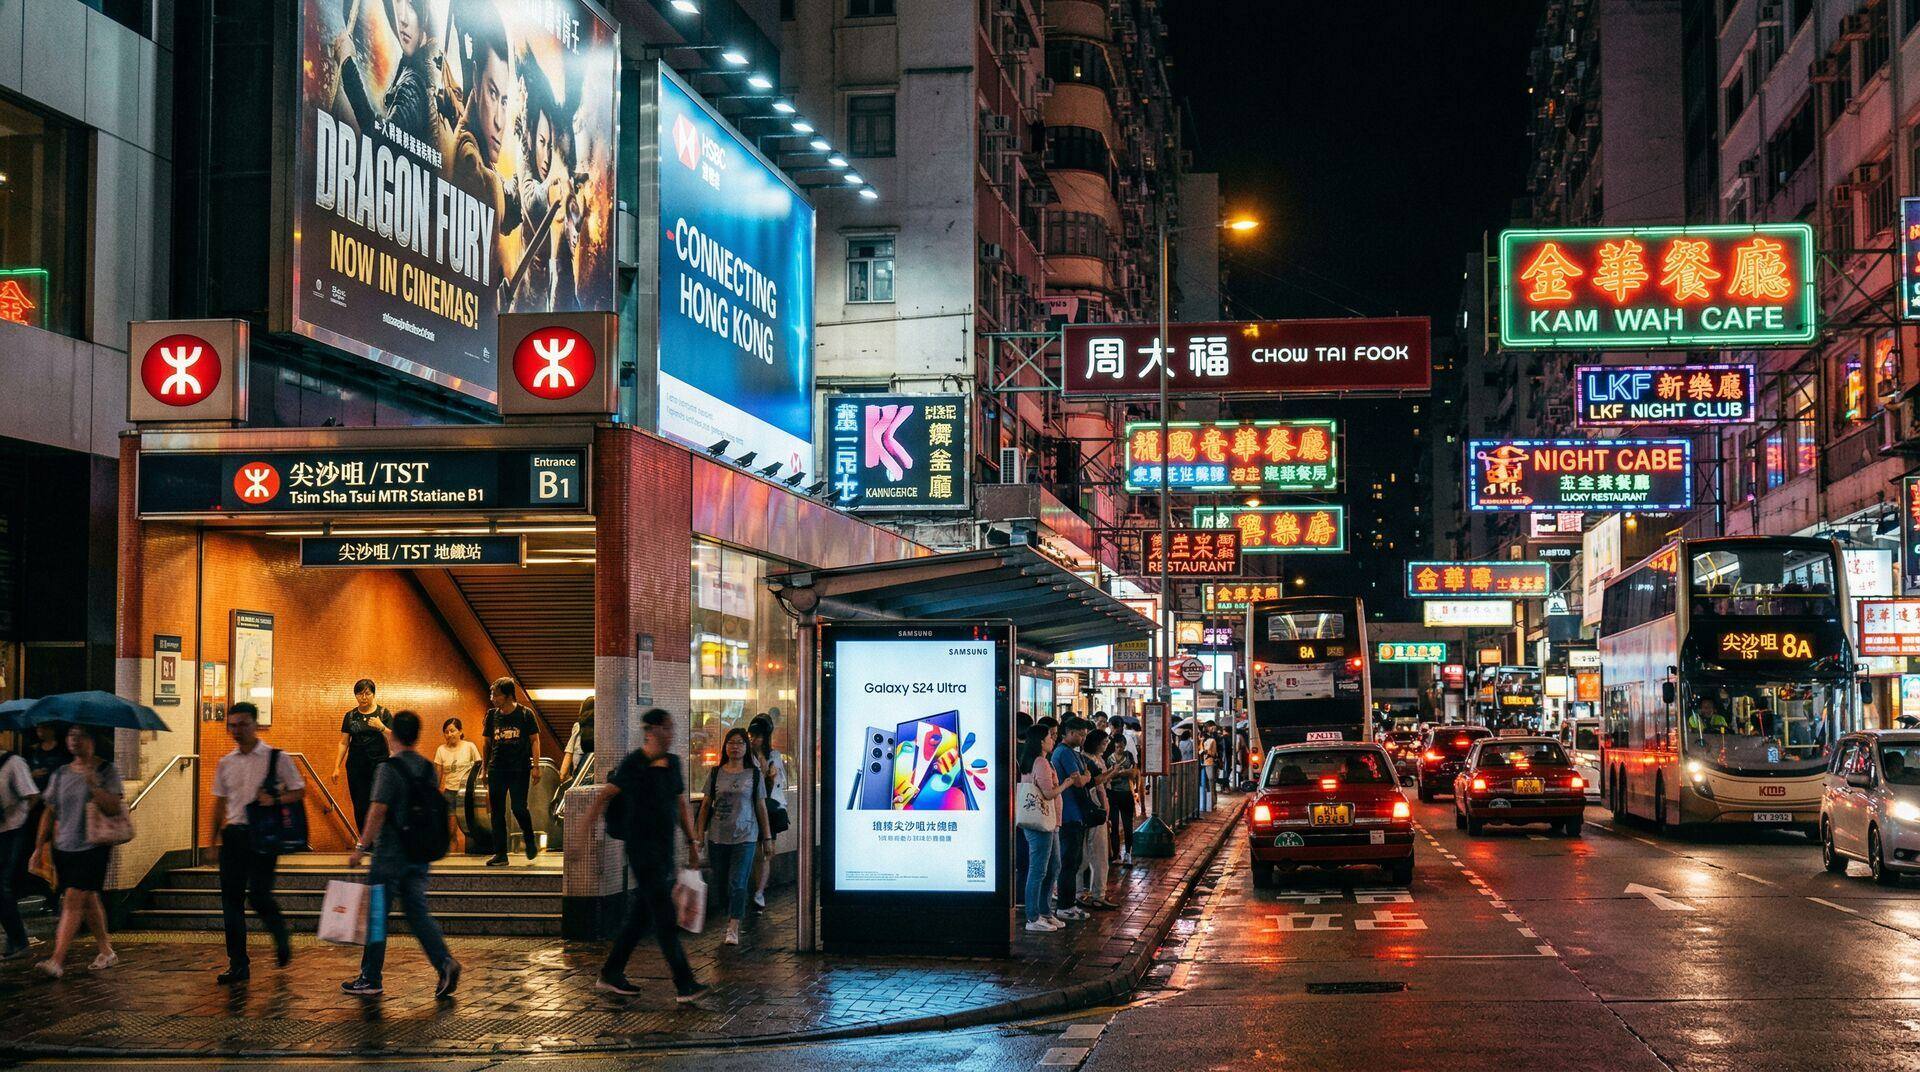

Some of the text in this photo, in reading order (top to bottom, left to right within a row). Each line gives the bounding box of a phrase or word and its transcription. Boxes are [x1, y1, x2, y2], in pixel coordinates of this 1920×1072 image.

[702, 132, 727, 170] HSBC
[316, 108, 495, 286] DRAGON FURY
[675, 217, 777, 319] CONNECTING
[1521, 239, 1791, 302] 金華餐廳
[330, 230, 374, 285] NOW
[379, 250, 398, 296] IN
[402, 263, 479, 330] CINEMAS!
[680, 273, 774, 365] HONG KONG
[1530, 306, 1784, 333] KAM WAH CAFE
[1085, 336, 1230, 379] 周大福
[1251, 345, 1409, 363] CHOW TAI FOOK
[1588, 373, 1652, 401] LKF
[1590, 402, 1743, 419] LKF NIGHT CLUB
[534, 457, 576, 467] Entrance
[1534, 449, 1683, 471] NIGHT CABE
[538, 470, 569, 499] B1
[289, 488, 484, 504] Tsim Sha Tsui MTR Statiane B1
[1591, 493, 1648, 501] RESTAURANT
[1148, 561, 1236, 572] RESTAURANT
[948, 648, 988, 656] SAMSUNG
[1299, 646, 1315, 659] 8A
[1723, 633, 1779, 651] 尖沙咀
[1782, 633, 1812, 659] 8A
[1741, 650, 1759, 659] TST
[864, 682, 967, 696] Galaxy S24 Ultra
